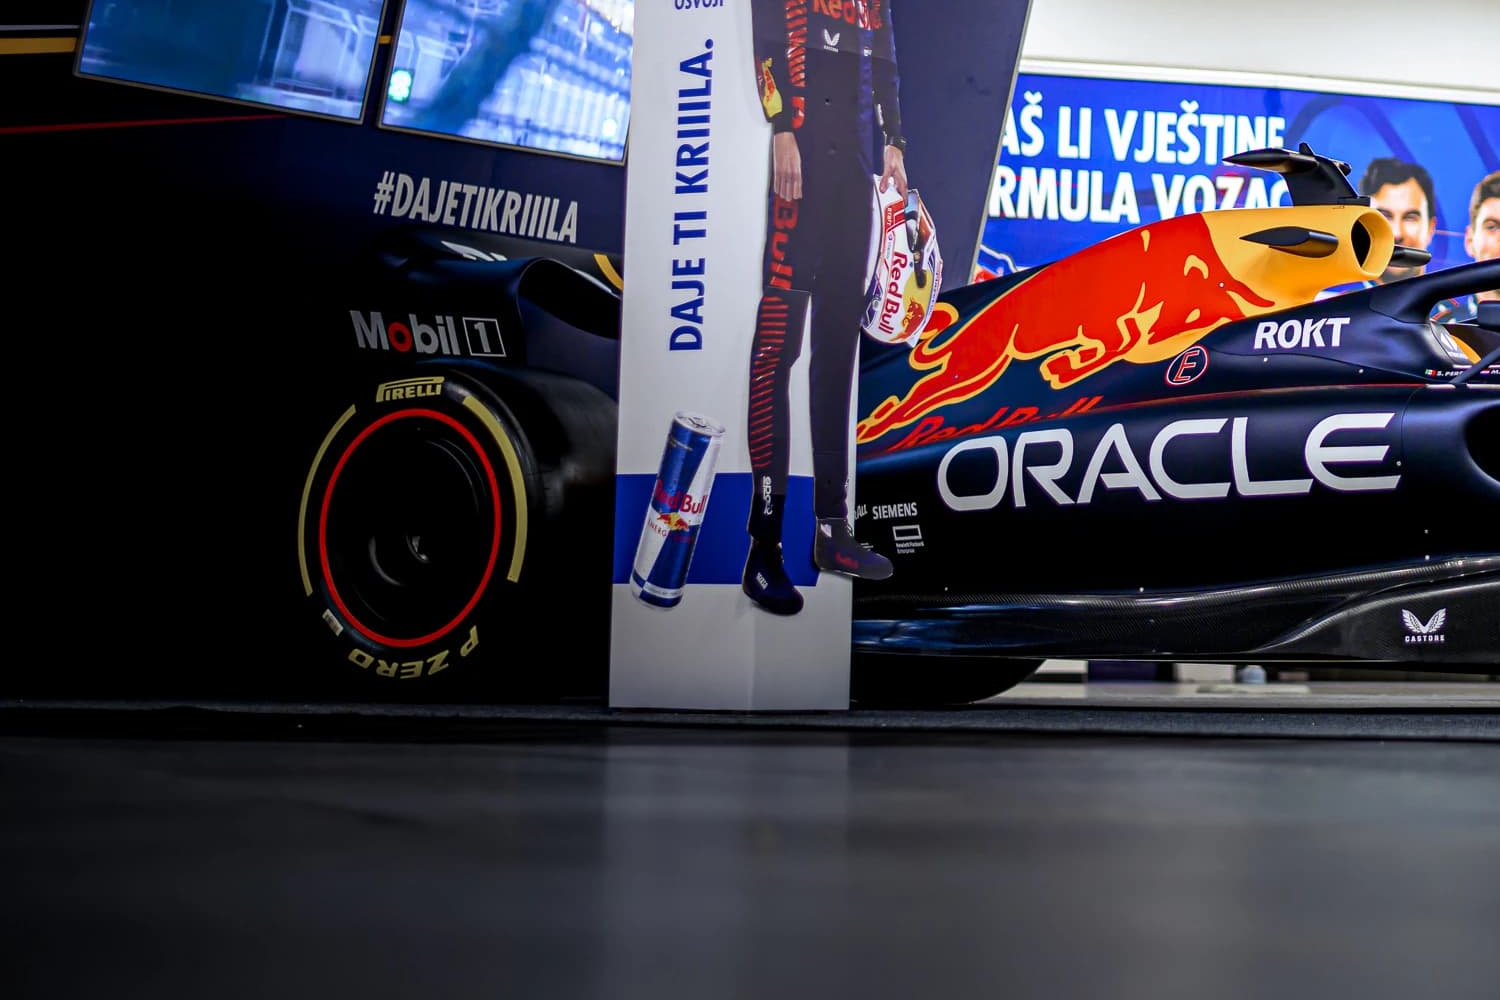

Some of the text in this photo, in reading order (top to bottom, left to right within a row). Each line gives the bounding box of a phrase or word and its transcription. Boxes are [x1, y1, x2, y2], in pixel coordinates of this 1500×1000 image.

[1002, 90, 1286, 166] AŠ LI VJEŠTINE
[669, 38, 714, 351] DAJE TI KRIIILA.
[989, 165, 1140, 223] RMULA
[878, 252, 908, 335] Red Bull
[351, 310, 463, 356] Mobil
[1254, 316, 1351, 349] ROKT
[375, 376, 446, 403] PIRELLI
[937, 412, 1402, 512] ORACLE
[680, 493, 709, 515] Bull
[872, 501, 918, 520] SIEMENS
[347, 623, 480, 680] P ZERO
[1404, 634, 1446, 644] CASTORE
